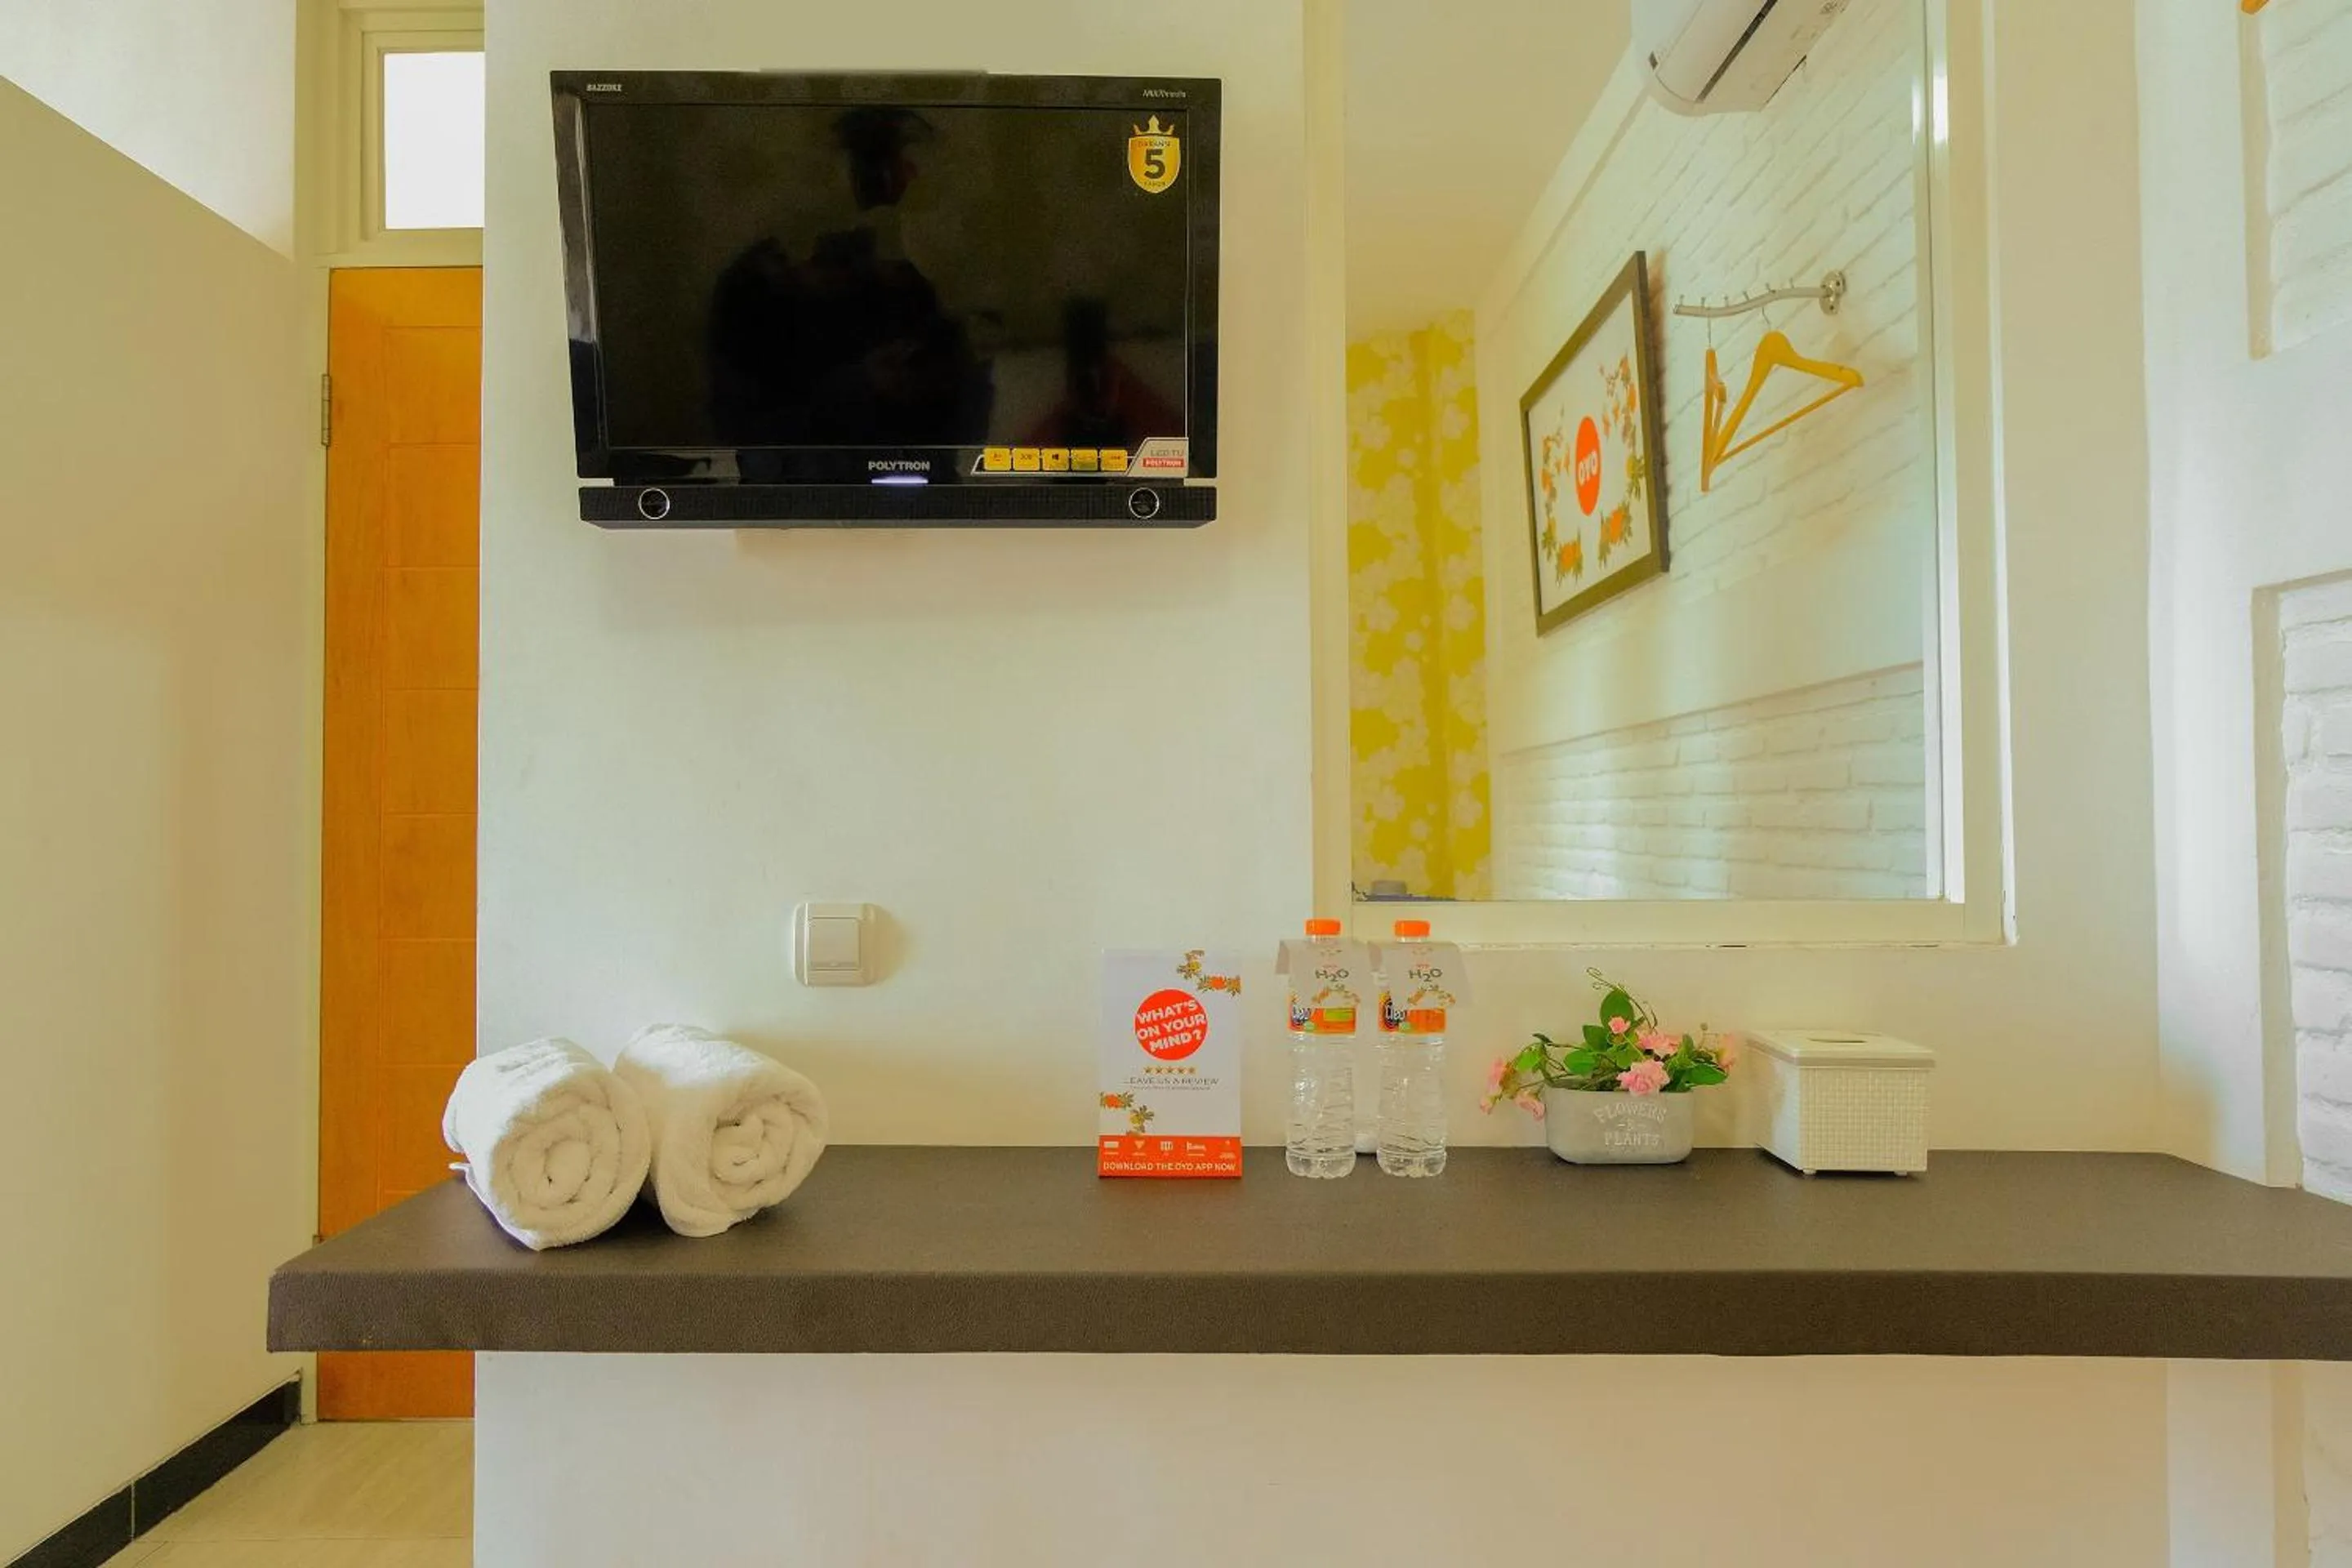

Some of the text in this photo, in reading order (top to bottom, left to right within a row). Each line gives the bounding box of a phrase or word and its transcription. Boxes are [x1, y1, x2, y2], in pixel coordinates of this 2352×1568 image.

[1144, 149, 1165, 179] 5
[868, 460, 931, 471] POLYTRON
[1315, 968, 1350, 982] H2O
[1409, 968, 1443, 982] H2O
[1137, 999, 1198, 1025] WHAT'S
[1137, 1013, 1206, 1040] ON YOUR
[1149, 1029, 1201, 1053] MIND?
[1593, 1102, 1667, 1123] FLOWERS
[1605, 1132, 1661, 1147] PLANTS
[1103, 1161, 1236, 1171] DOWNLOAD THE OYO APP NOW
